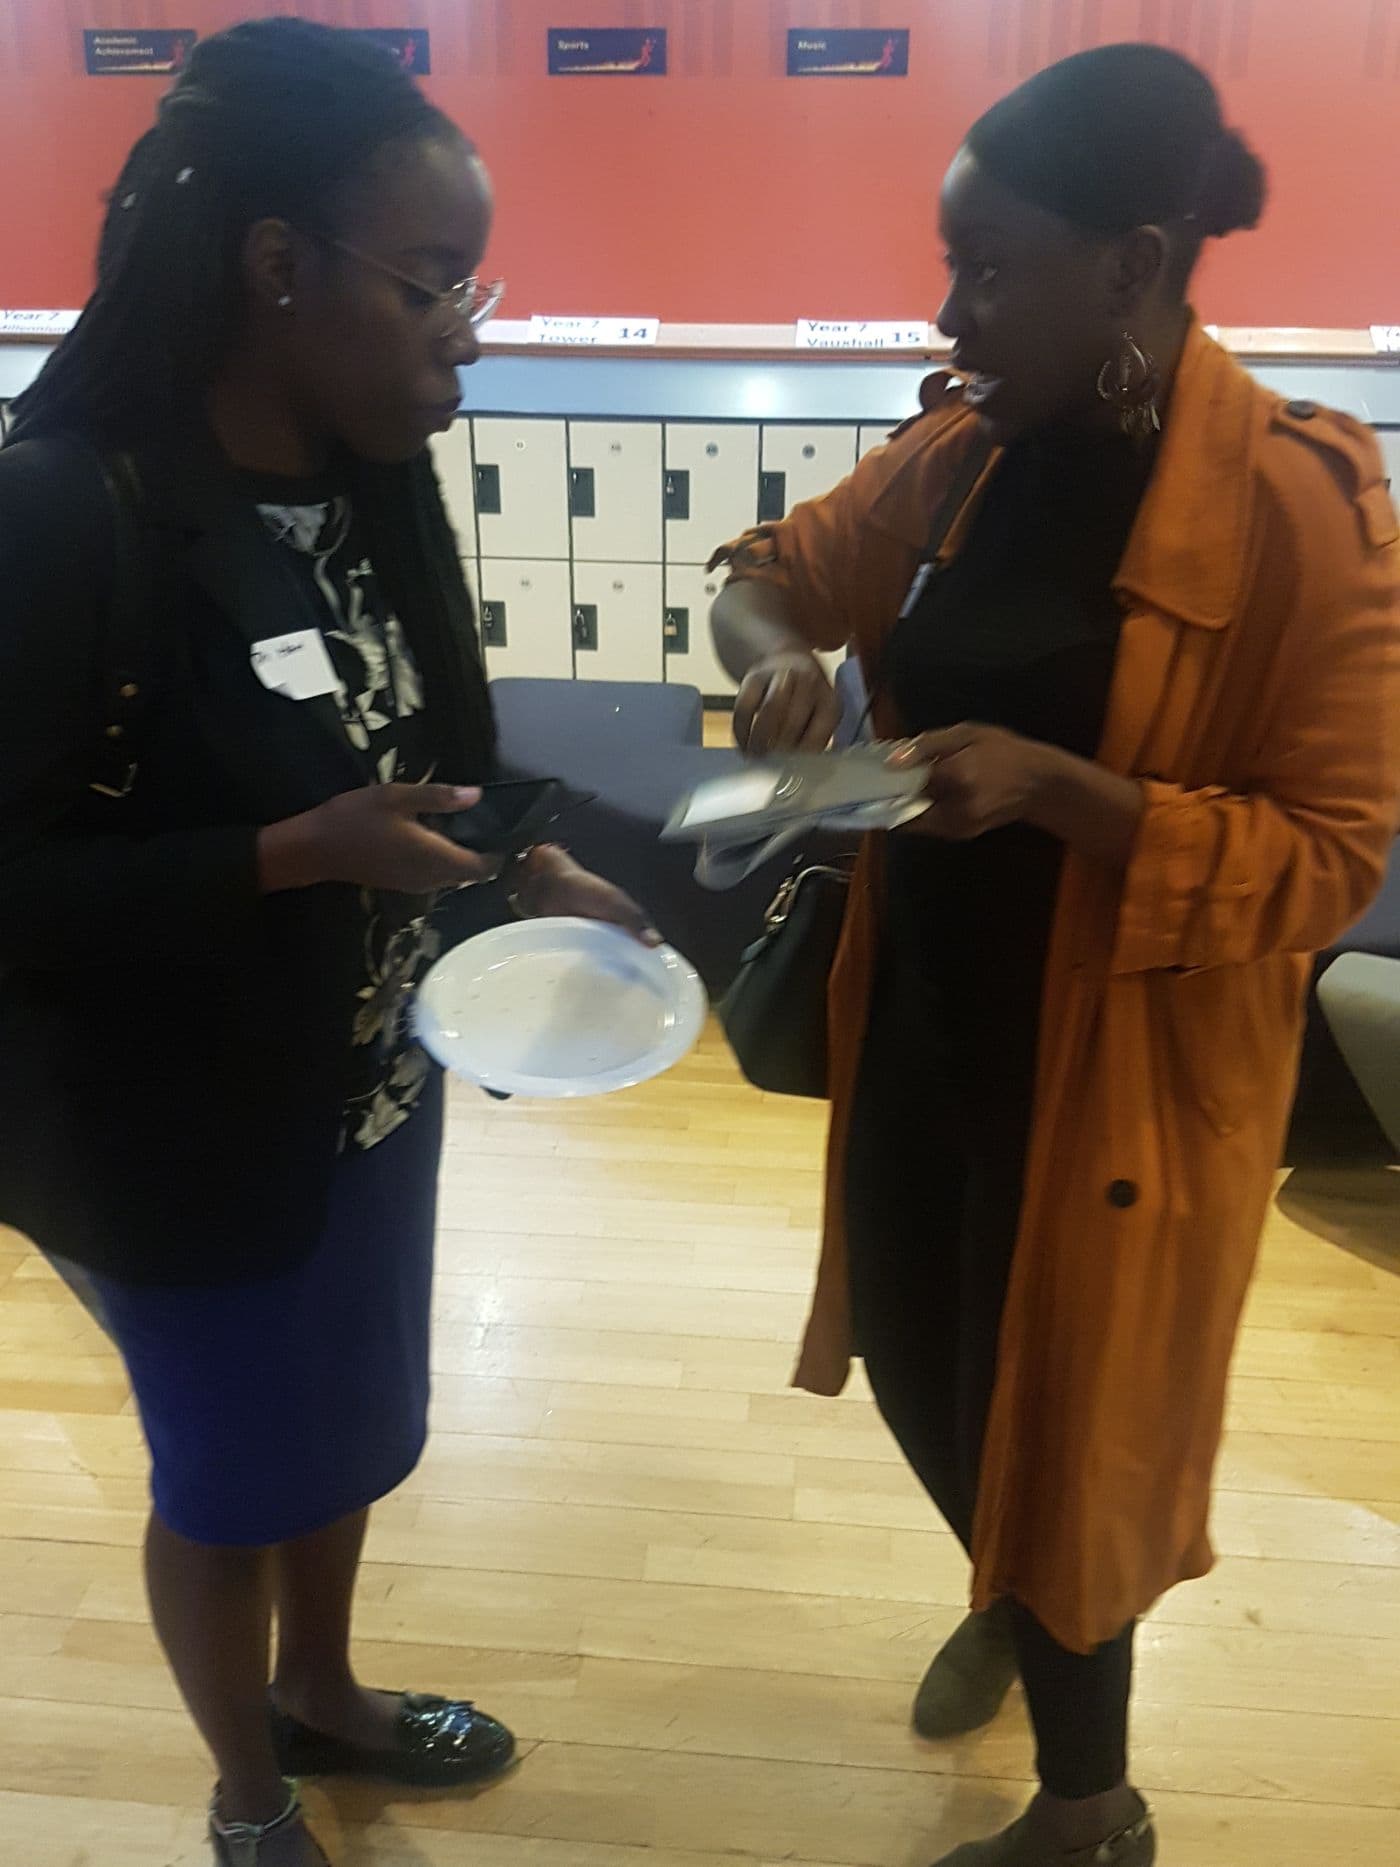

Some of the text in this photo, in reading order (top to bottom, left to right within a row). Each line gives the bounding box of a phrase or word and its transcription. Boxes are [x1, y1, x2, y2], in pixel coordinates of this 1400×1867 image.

[558, 40, 589, 50] Sports
[798, 41, 826, 50] Music
[95, 48, 154, 56] Achievement
[4, 311, 42, 320] Year
[542, 317, 581, 327] Year
[808, 321, 848, 332] Year
[619, 327, 648, 338] 14
[894, 332, 920, 342] 15
